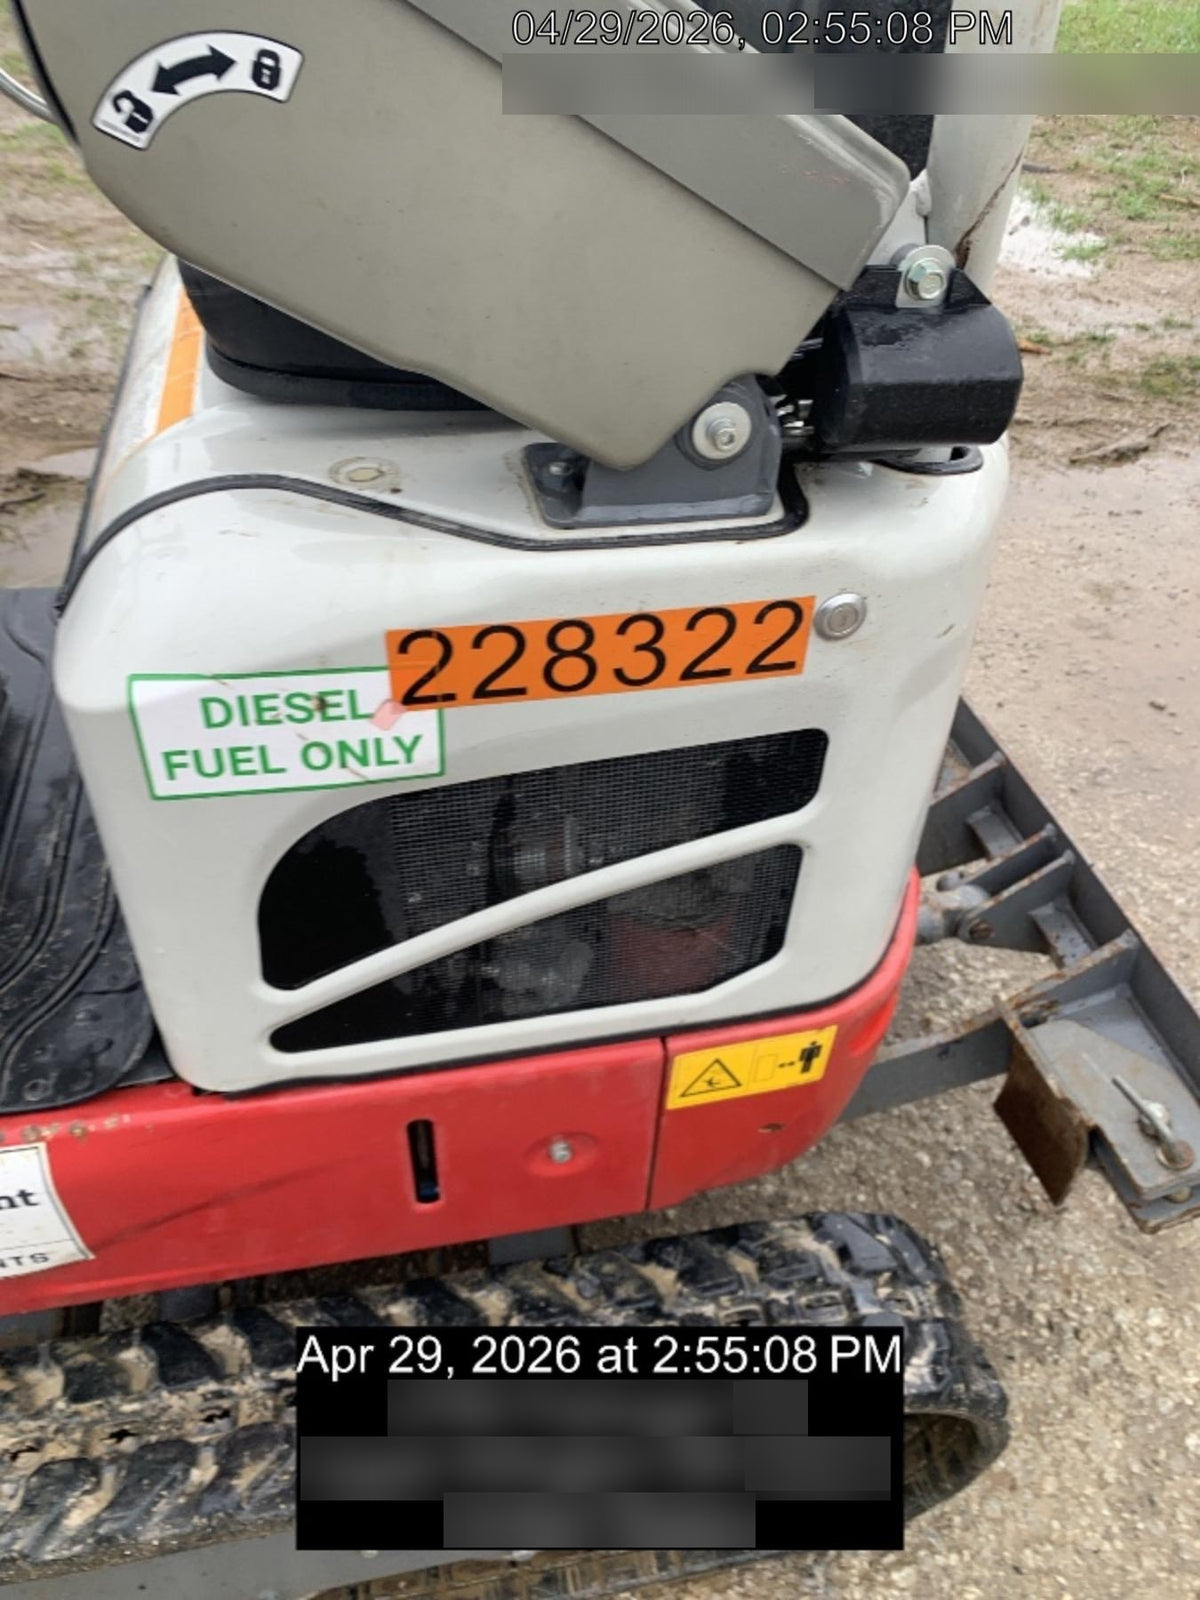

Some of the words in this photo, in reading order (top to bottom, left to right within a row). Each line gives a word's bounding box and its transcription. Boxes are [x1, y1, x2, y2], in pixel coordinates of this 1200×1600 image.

[397, 599, 805, 707] 228322
[200, 689, 375, 729] DIESEL
[162, 745, 286, 781] FUEL
[300, 735, 422, 771] ONLY
